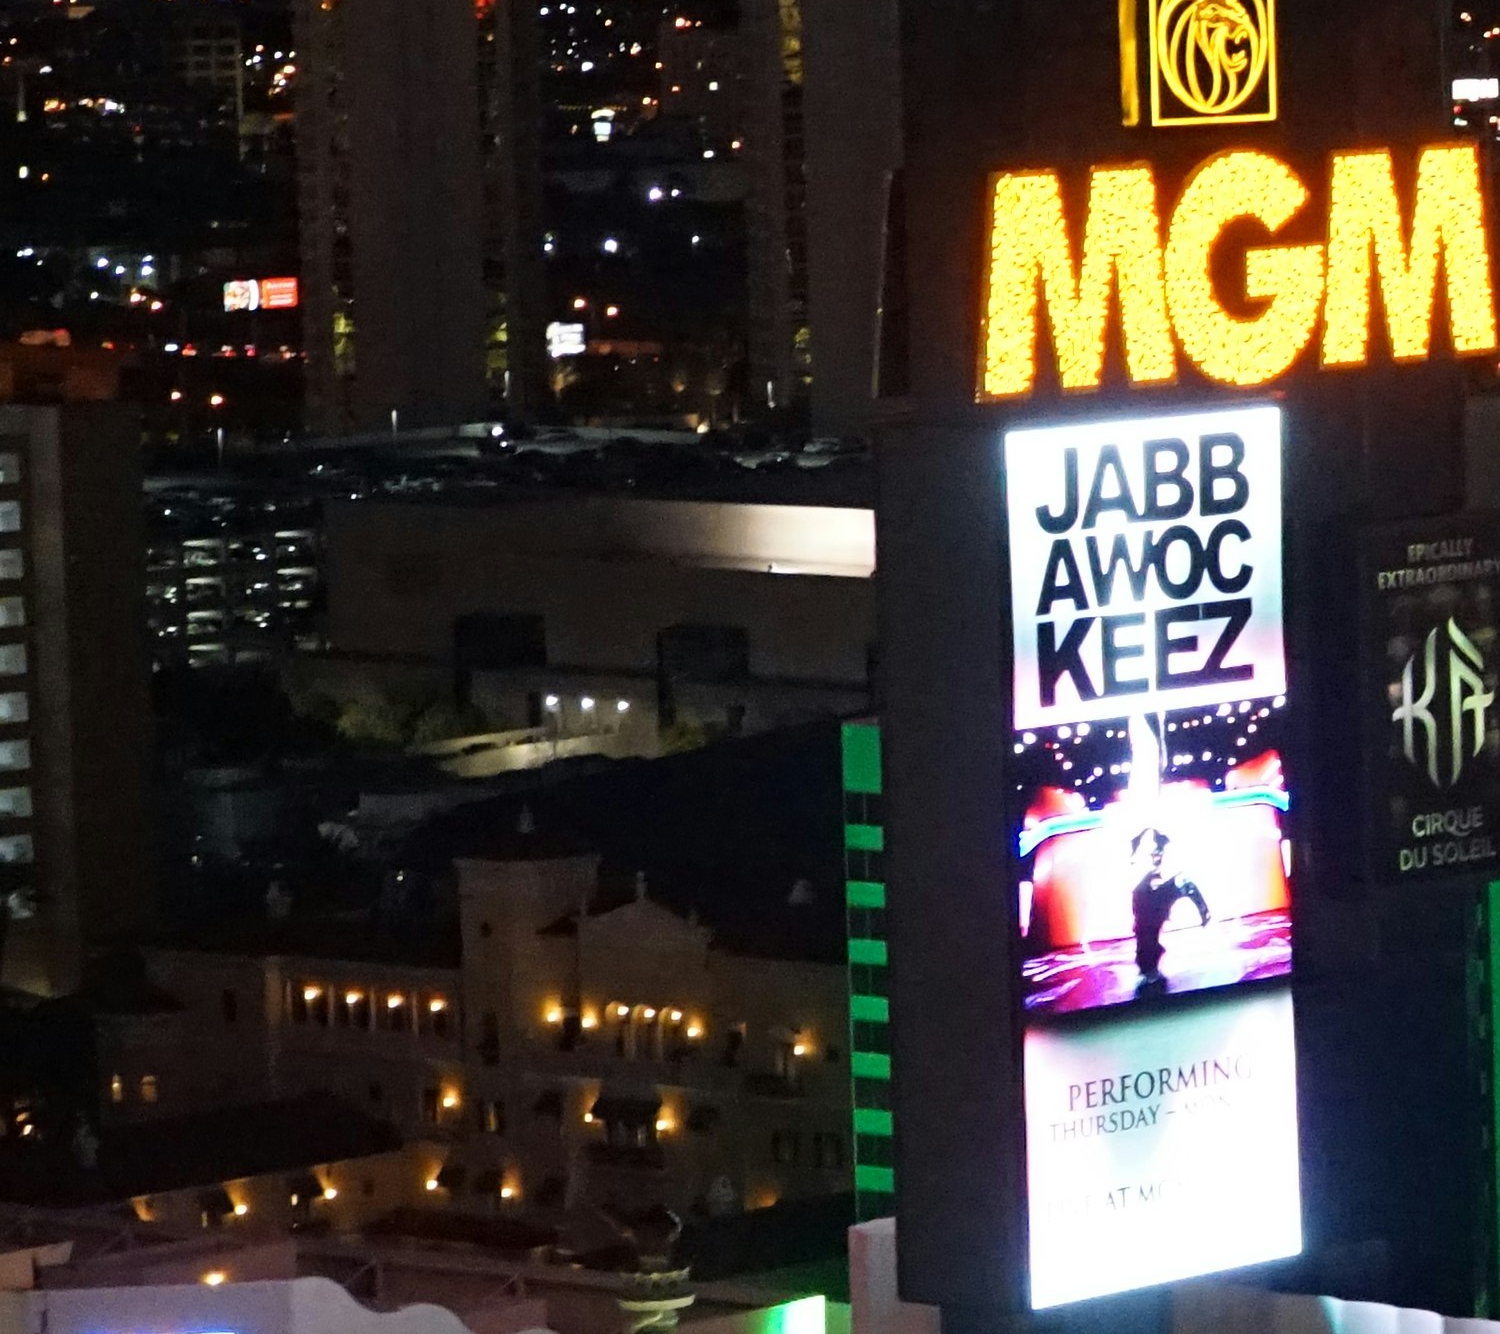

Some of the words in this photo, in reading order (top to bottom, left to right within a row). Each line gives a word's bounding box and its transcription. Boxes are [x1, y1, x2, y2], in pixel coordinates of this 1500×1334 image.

[978, 143, 1497, 400] MGM
[1034, 431, 1251, 535] JABB
[1034, 518, 1255, 617] AWOC
[1035, 596, 1255, 709] KEEZ
[1411, 805, 1485, 838] CIRQUE
[1399, 845, 1428, 871] DU
[1432, 837, 1497, 866] SOLEIL
[1069, 1055, 1252, 1112] PERFORMING
[1049, 1103, 1161, 1144] THURSDAY
[1105, 1186, 1131, 1211] AT
